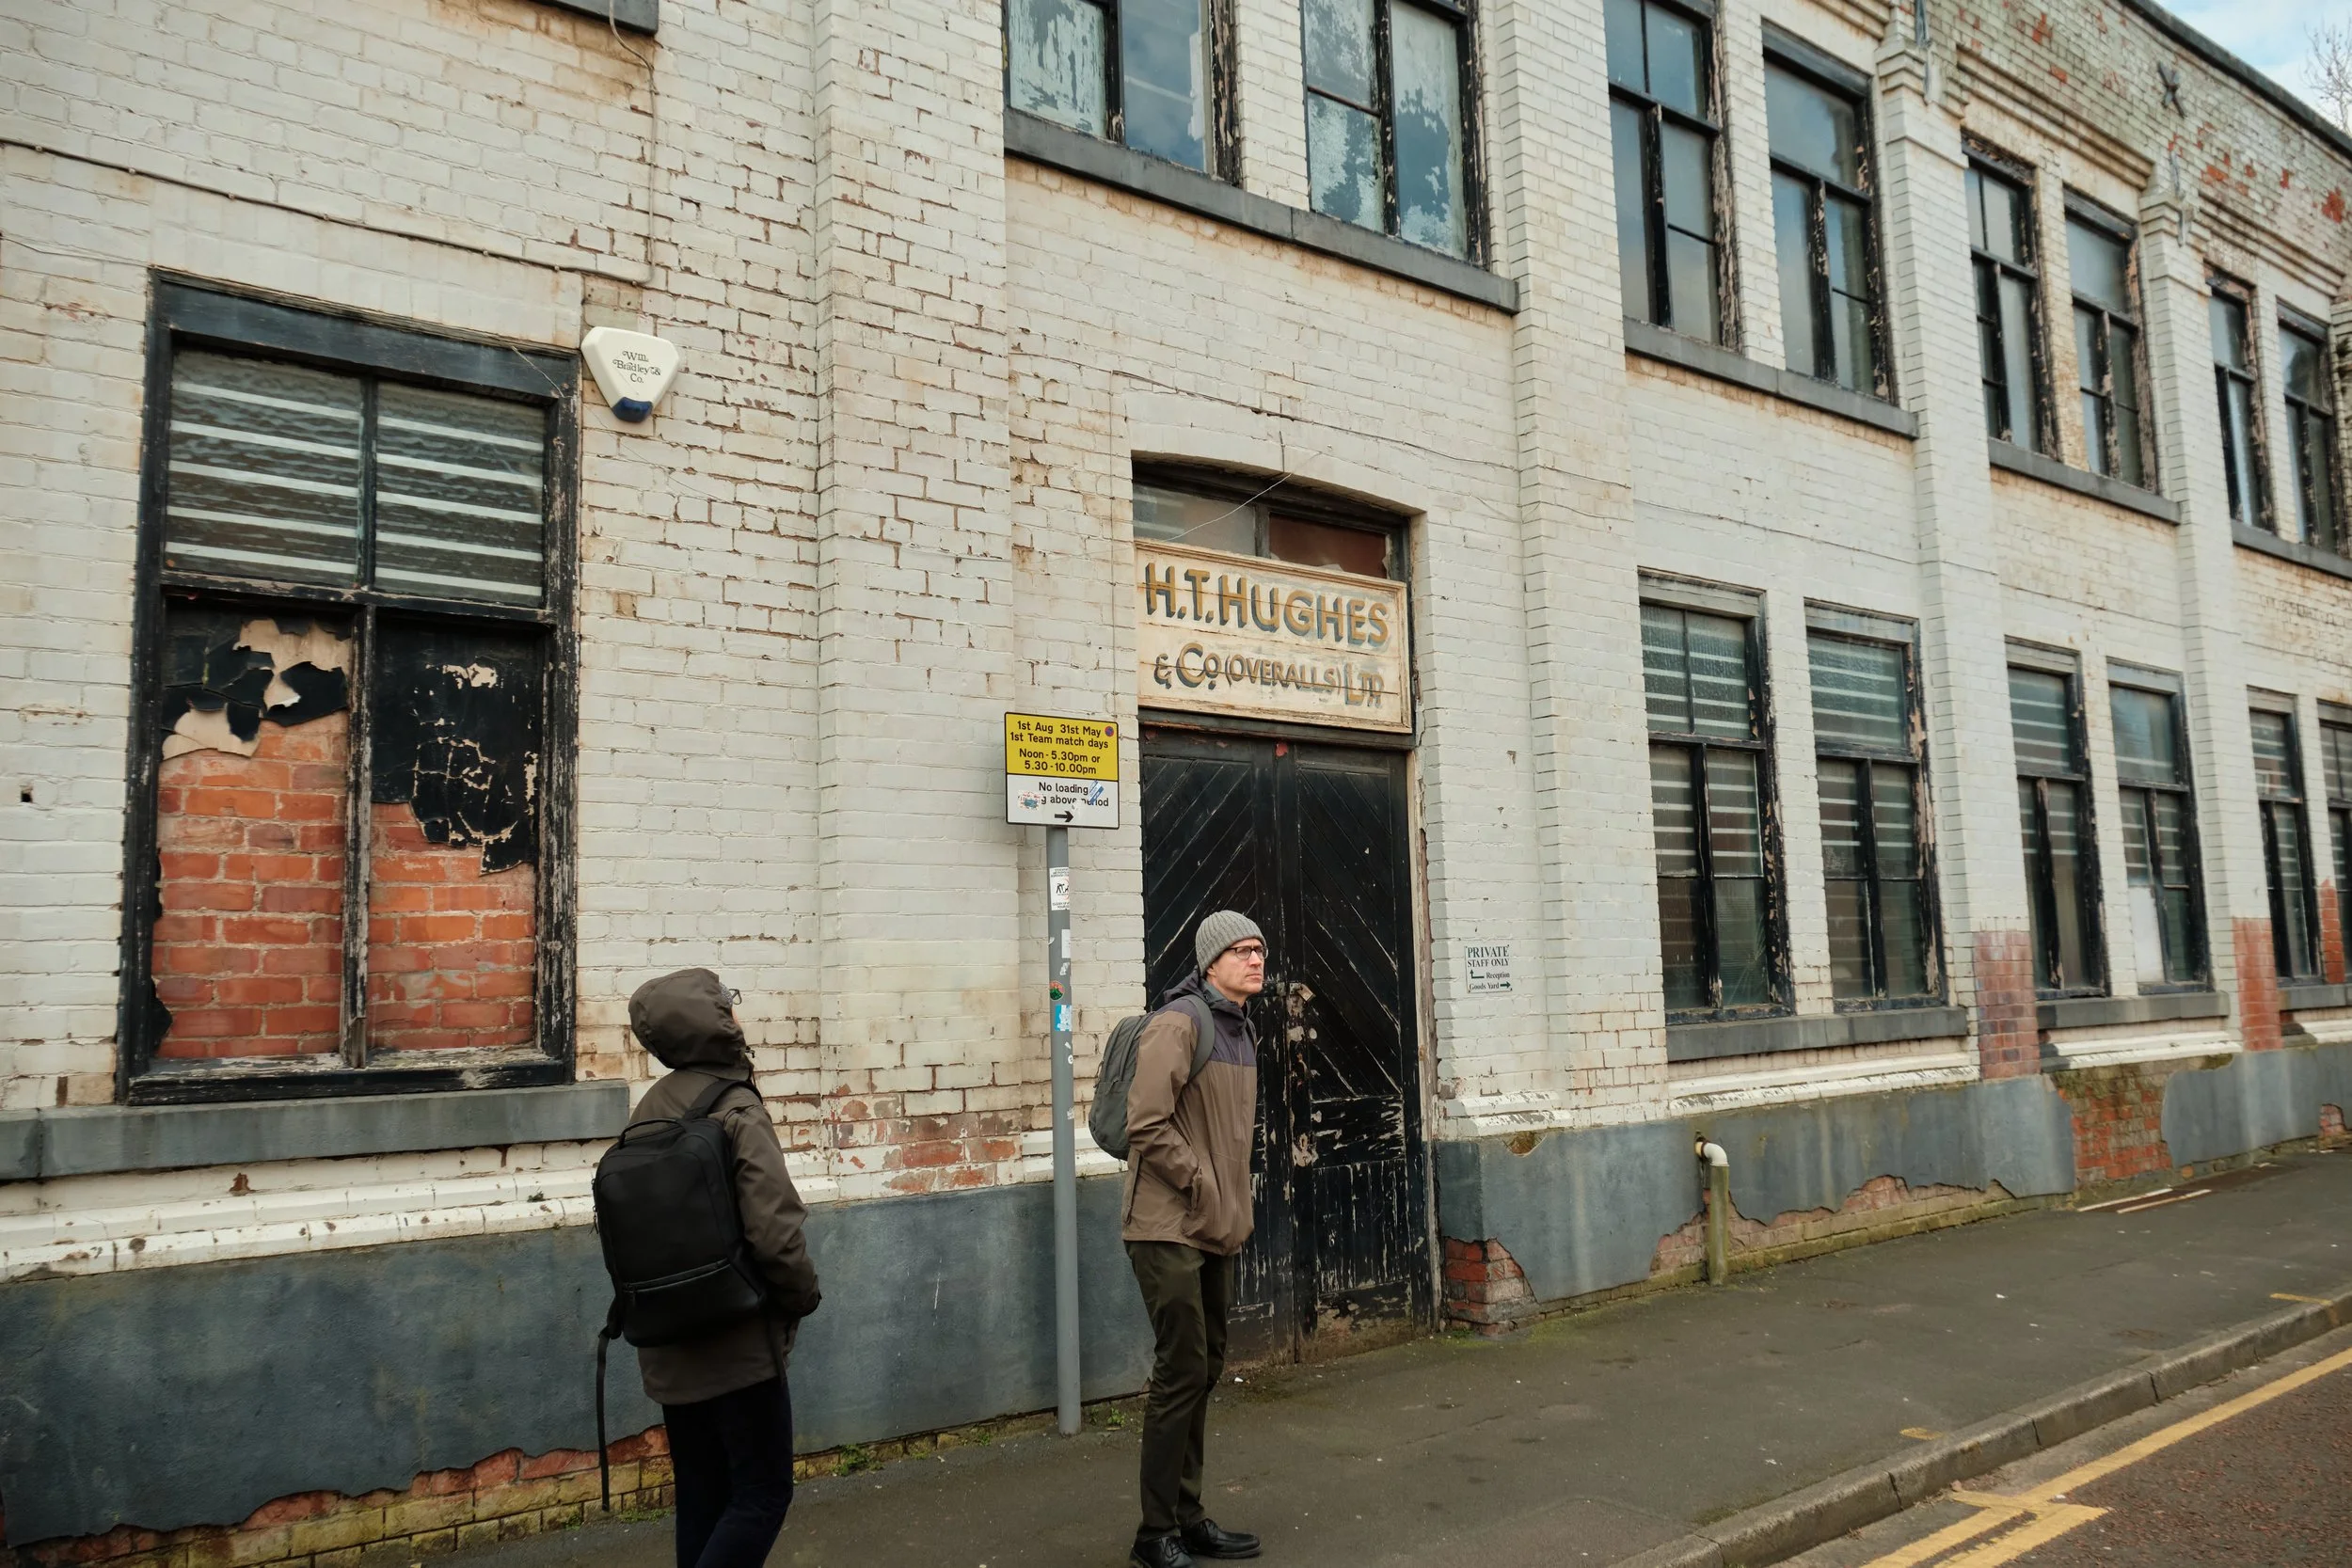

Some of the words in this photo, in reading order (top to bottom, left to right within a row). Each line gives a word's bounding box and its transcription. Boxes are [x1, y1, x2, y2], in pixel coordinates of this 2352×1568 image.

[612, 359, 650, 375] Bradley
[1153, 653, 1172, 689] &
[1017, 721, 1031, 731] 1st
[1035, 721, 1054, 734] Aug
[1059, 723, 1079, 735] 31st
[1083, 726, 1102, 737] May
[1010, 732, 1024, 742] 1st
[1027, 734, 1053, 744] Team
[1056, 736, 1084, 747] match
[1088, 738, 1109, 750] days
[1019, 748, 1044, 759] Noon
[1051, 751, 1089, 763] 5.30pm
[1091, 754, 1101, 763] or
[1025, 760, 1048, 771] 5.30
[1055, 762, 1097, 775] 10.00pm
[1039, 782, 1053, 792] No
[1056, 783, 1089, 795] loading
[1468, 946, 1509, 958] PRIVATE
[1468, 958, 1489, 967] STAFF
[1491, 958, 1509, 966] ONLY
[1486, 971, 1510, 980] Reception
[1487, 981, 1500, 990] Yard
